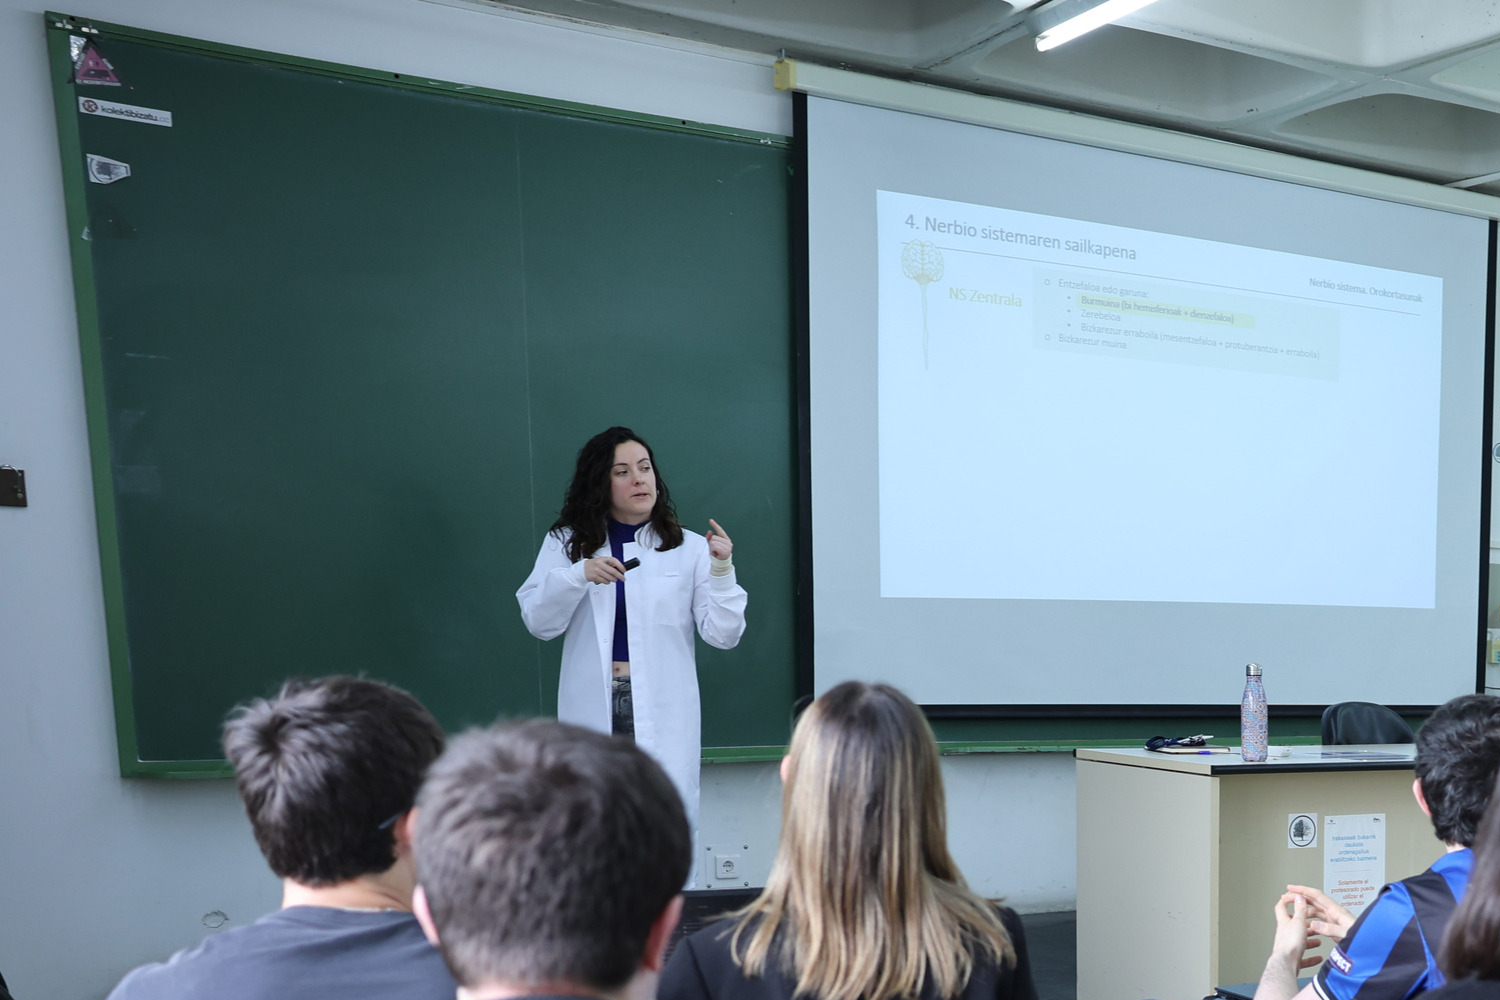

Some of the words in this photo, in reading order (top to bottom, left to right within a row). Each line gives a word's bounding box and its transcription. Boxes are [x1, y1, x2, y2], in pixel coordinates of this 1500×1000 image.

[904, 214, 920, 230] 4.
[924, 216, 978, 238] Nerbio
[981, 225, 1061, 250] sistemaren
[1064, 238, 1136, 260] sailkapena
[1058, 279, 1100, 292] Entzefaloa
[1102, 285, 1118, 294] edo
[1309, 278, 1335, 290] Nerbio
[1369, 286, 1423, 302] Orokortasunak
[949, 287, 966, 300] NS
[970, 289, 1023, 308] Zentrala
[1058, 333, 1099, 346] Bizkarezur
[1082, 322, 1122, 336] Bizkarezur
[1124, 330, 1158, 340] erraboila
